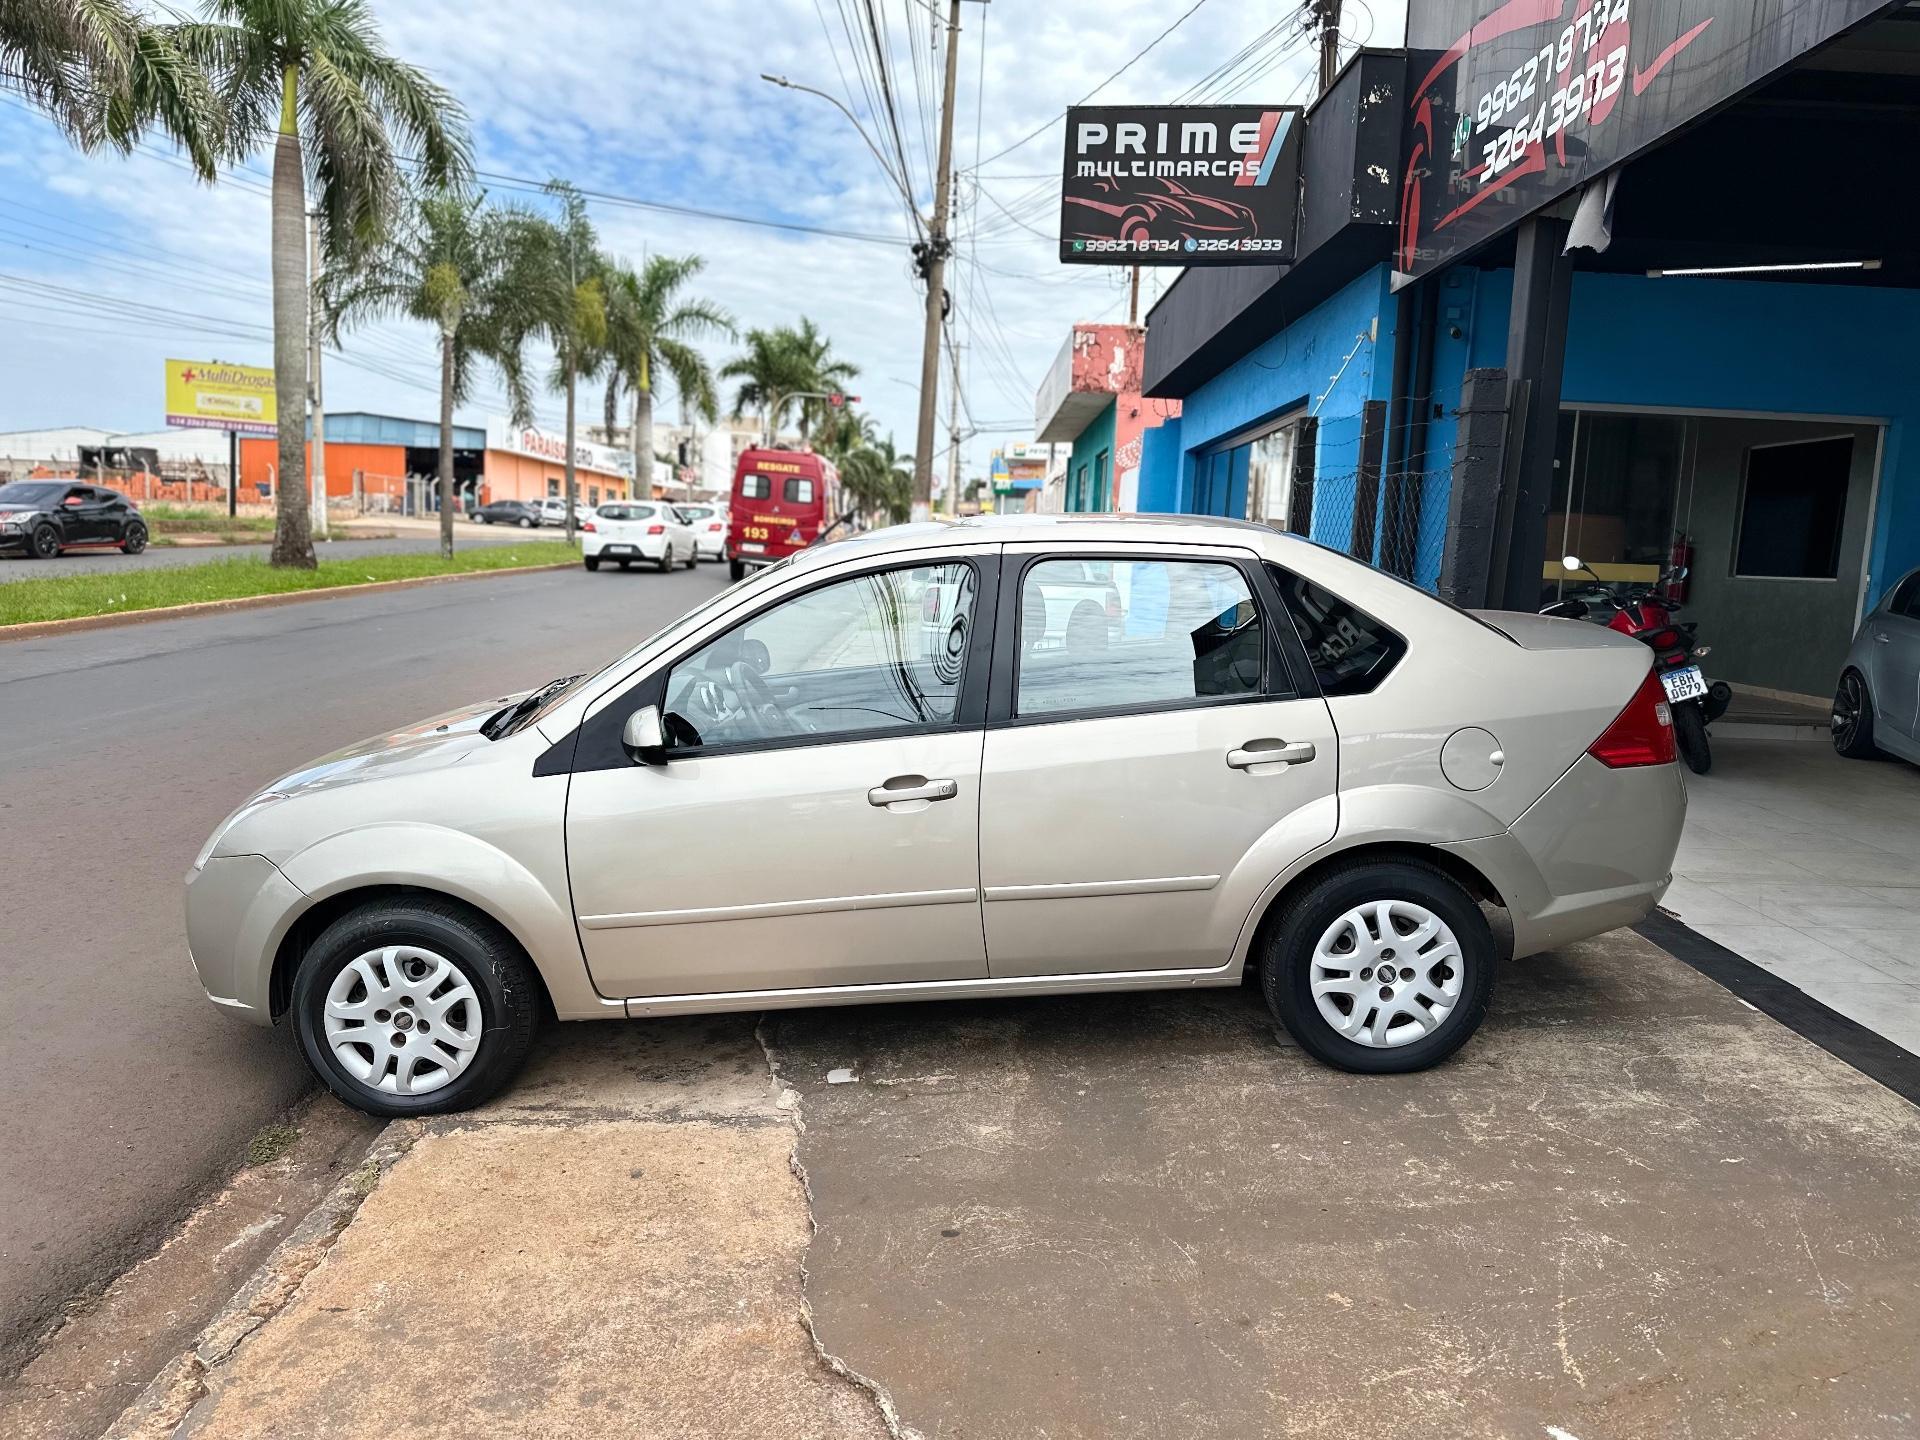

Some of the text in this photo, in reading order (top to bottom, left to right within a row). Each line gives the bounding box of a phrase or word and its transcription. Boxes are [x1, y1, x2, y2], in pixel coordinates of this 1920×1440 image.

[1077, 122, 1261, 154] PRIME
[1076, 160, 1262, 177] MULTIMARCAS
[757, 461, 800, 473] RESGATE
[753, 515, 797, 526] BOMBEIROS
[743, 526, 769, 539] 193
[1671, 674, 1695, 688] EBH
